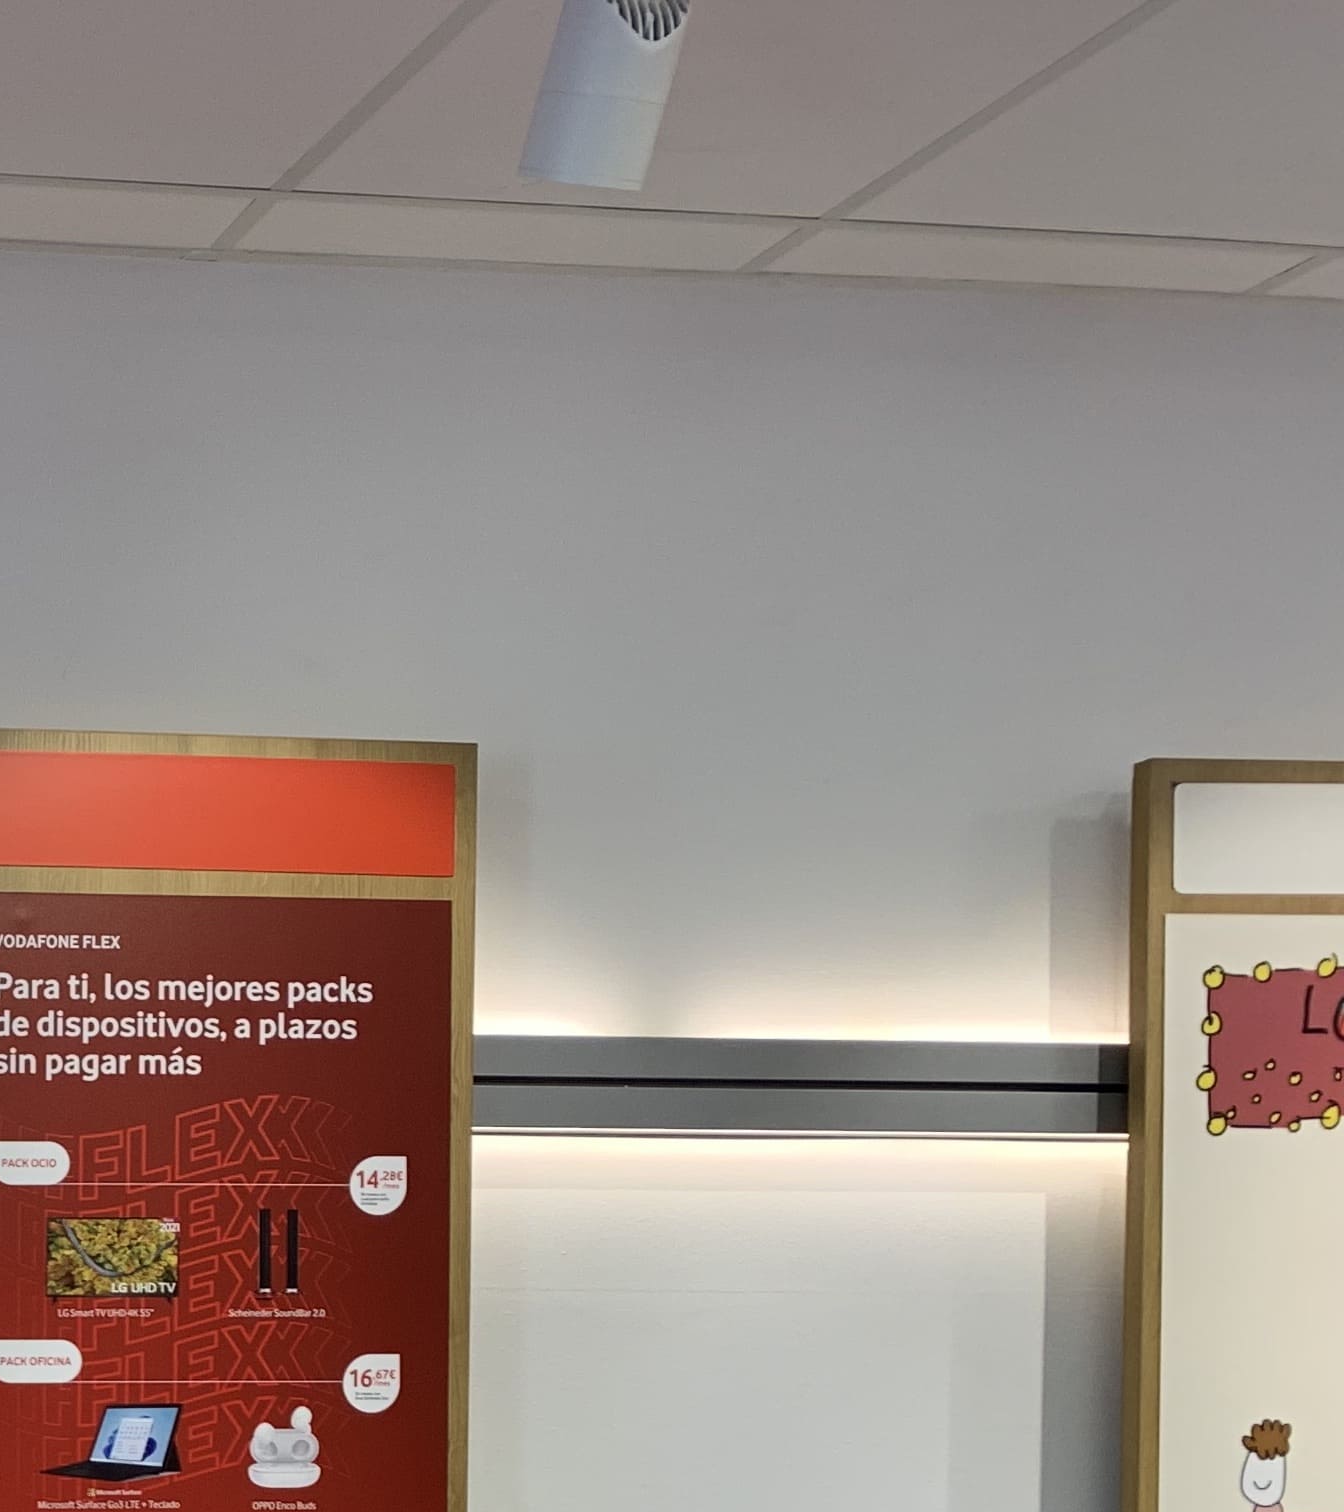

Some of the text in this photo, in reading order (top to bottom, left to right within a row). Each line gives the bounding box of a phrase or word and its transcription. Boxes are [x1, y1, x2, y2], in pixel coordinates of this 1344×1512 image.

[82, 935, 121, 949] FLEX
[67, 973, 96, 1003] ti,
[104, 973, 150, 1000] los
[158, 974, 280, 1008] mejores
[287, 976, 373, 1008] packs
[36, 1010, 227, 1044] dispositivos,
[234, 1017, 250, 1038] a
[259, 1012, 358, 1045] plazos
[45, 1053, 131, 1081] pagar
[138, 1046, 202, 1075] más
[1, 1158, 57, 1168] PACK OCIO
[111, 1282, 177, 1293] LG UHD TV
[57, 1308, 69, 1318] LG
[70, 1308, 94, 1318] Smart
[95, 1308, 107, 1318] TV
[0, 1356, 72, 1366] PACK OFICINA
[37, 1500, 76, 1510] Microsoft
[77, 1500, 106, 1510] Surface
[125, 1500, 140, 1510] LTE
[148, 1500, 181, 1510] Teclado
[252, 1501, 317, 1511] OPPO Enco Buds
